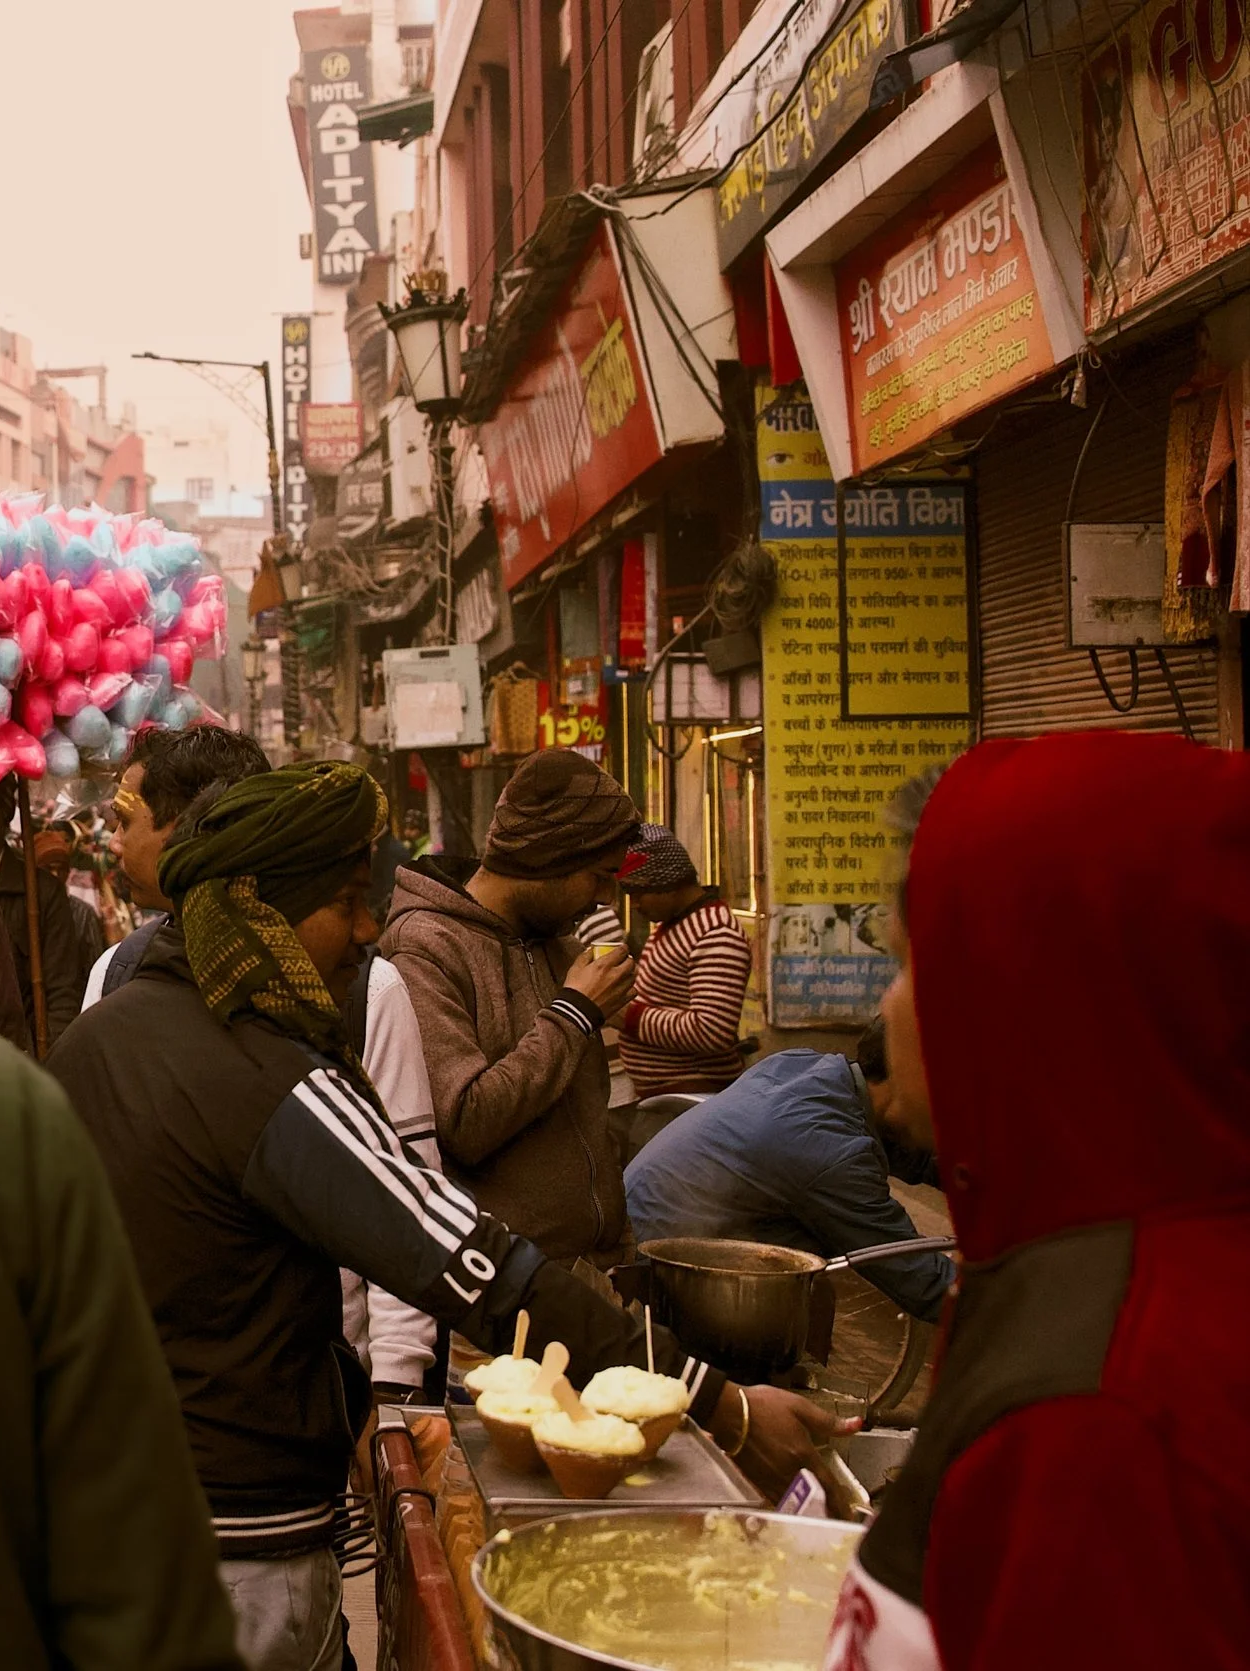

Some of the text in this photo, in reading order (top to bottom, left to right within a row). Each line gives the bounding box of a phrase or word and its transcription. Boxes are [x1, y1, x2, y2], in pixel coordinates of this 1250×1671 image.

[310, 83, 364, 102] HOTEL
[316, 103, 371, 252] ADITYA
[849, 278, 876, 355] श्री
[879, 239, 939, 329] श्याम
[770, 489, 813, 528] नेत्र
[906, 488, 965, 526] विभा
[539, 710, 606, 747] 15%
